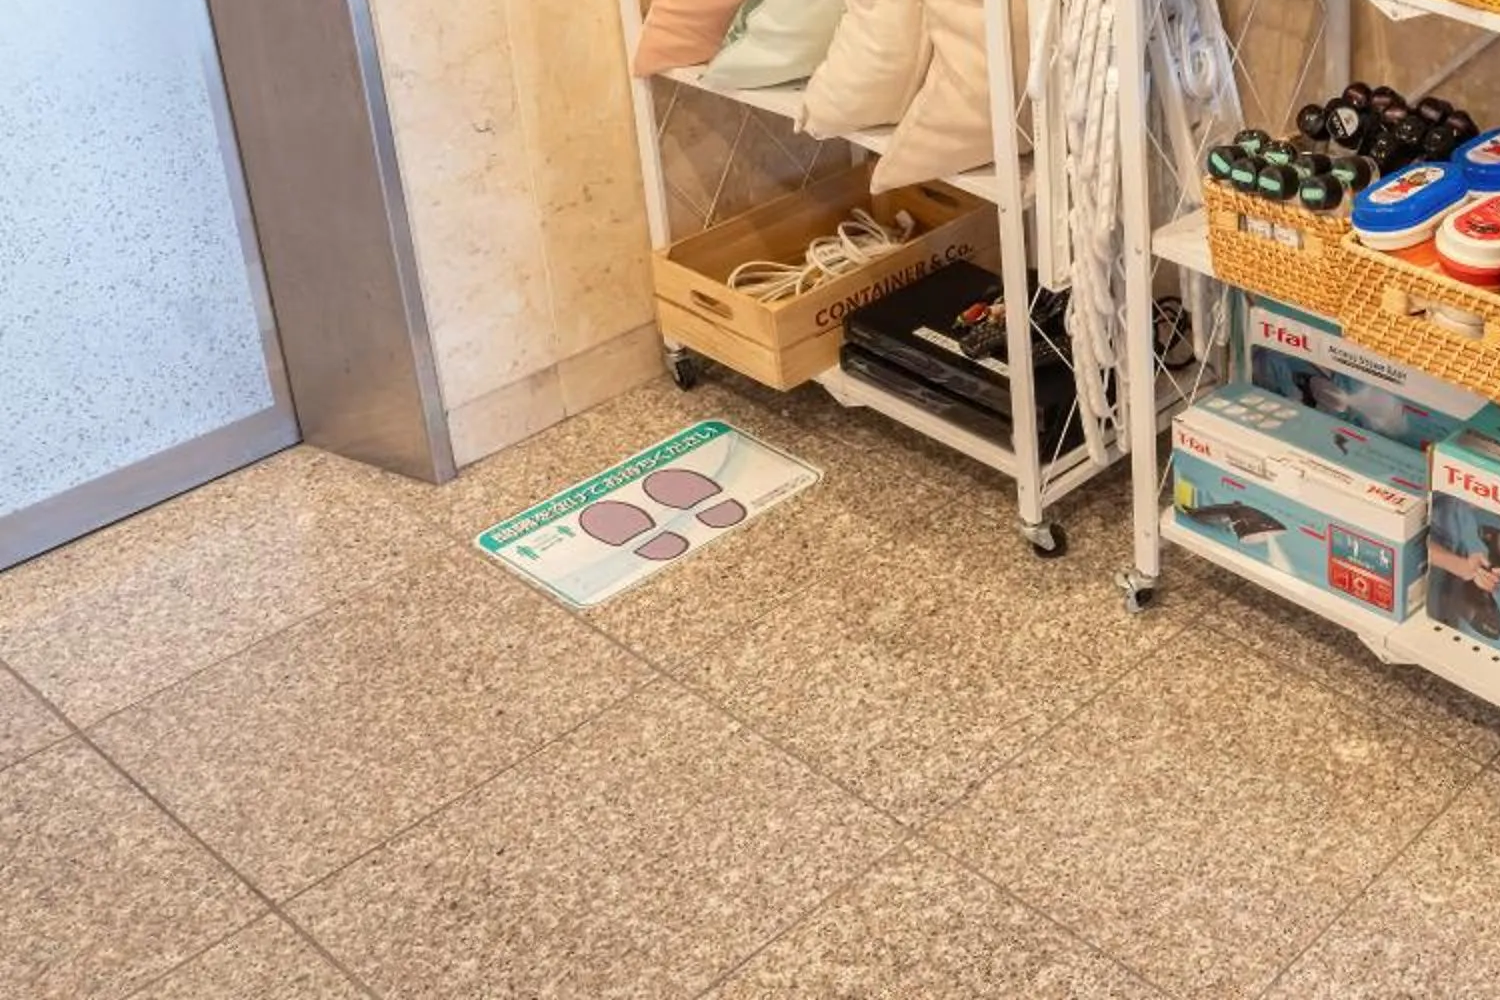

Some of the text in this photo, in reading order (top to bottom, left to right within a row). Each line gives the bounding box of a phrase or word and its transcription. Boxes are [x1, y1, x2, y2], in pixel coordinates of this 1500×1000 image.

[814, 258, 929, 328] CONTAINER
[944, 243, 975, 264] Co.
[1258, 320, 1312, 352] T-fal
[1176, 431, 1212, 457] T-fal
